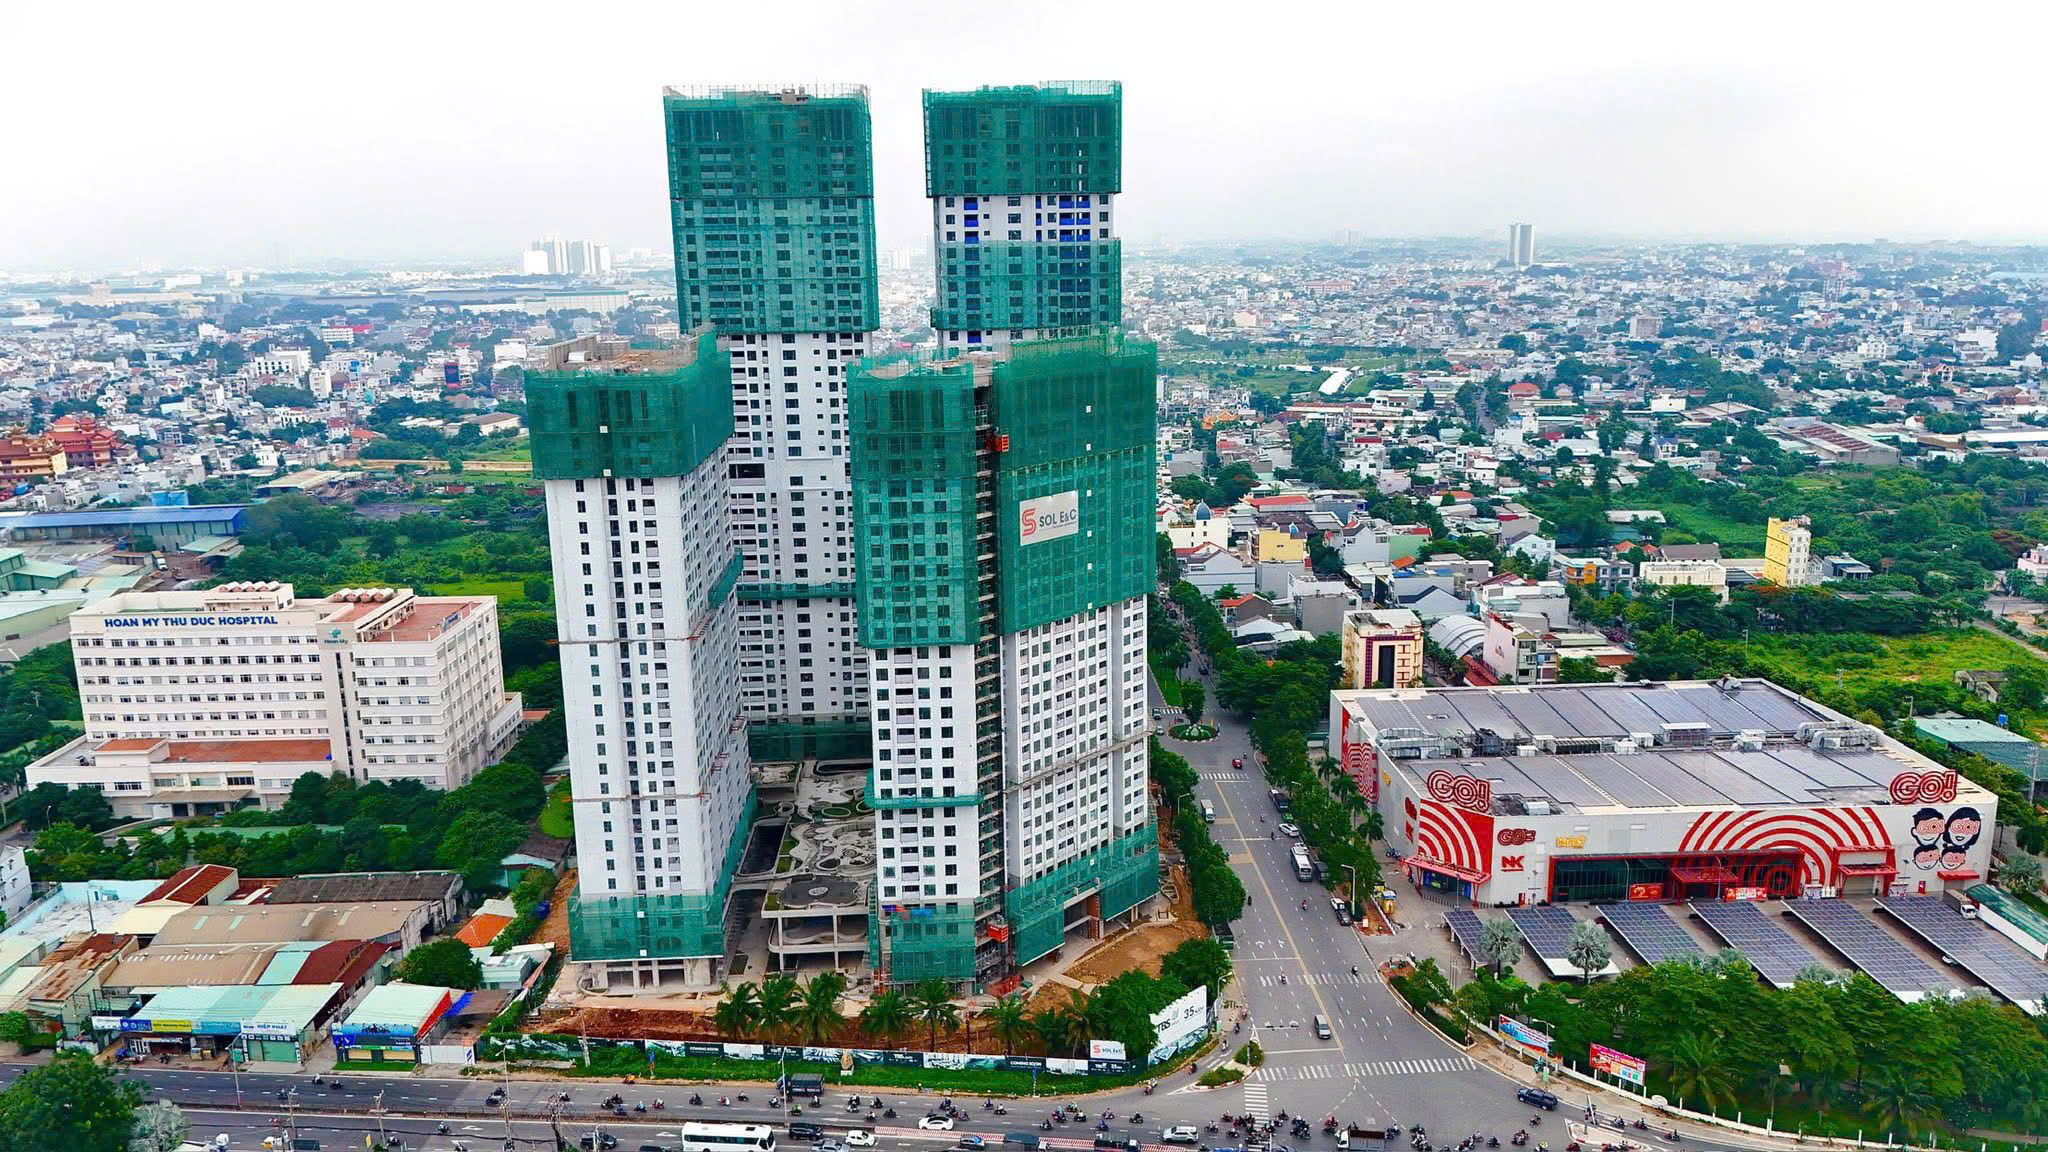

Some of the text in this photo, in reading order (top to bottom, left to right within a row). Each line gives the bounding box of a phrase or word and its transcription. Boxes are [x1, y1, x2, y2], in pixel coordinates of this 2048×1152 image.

[1040, 513, 1057, 527] SOL
[1060, 509, 1077, 523] E&C
[104, 615, 278, 627] HOAN MY THU DUC HOSPITAL
[1427, 770, 1490, 812] GO!
[1889, 769, 1959, 804] GO!
[1497, 828, 1536, 846] GO!
[1501, 855, 1525, 869] NK
[1157, 1018, 1172, 1034] TBS
[1183, 1005, 1195, 1020] 35
